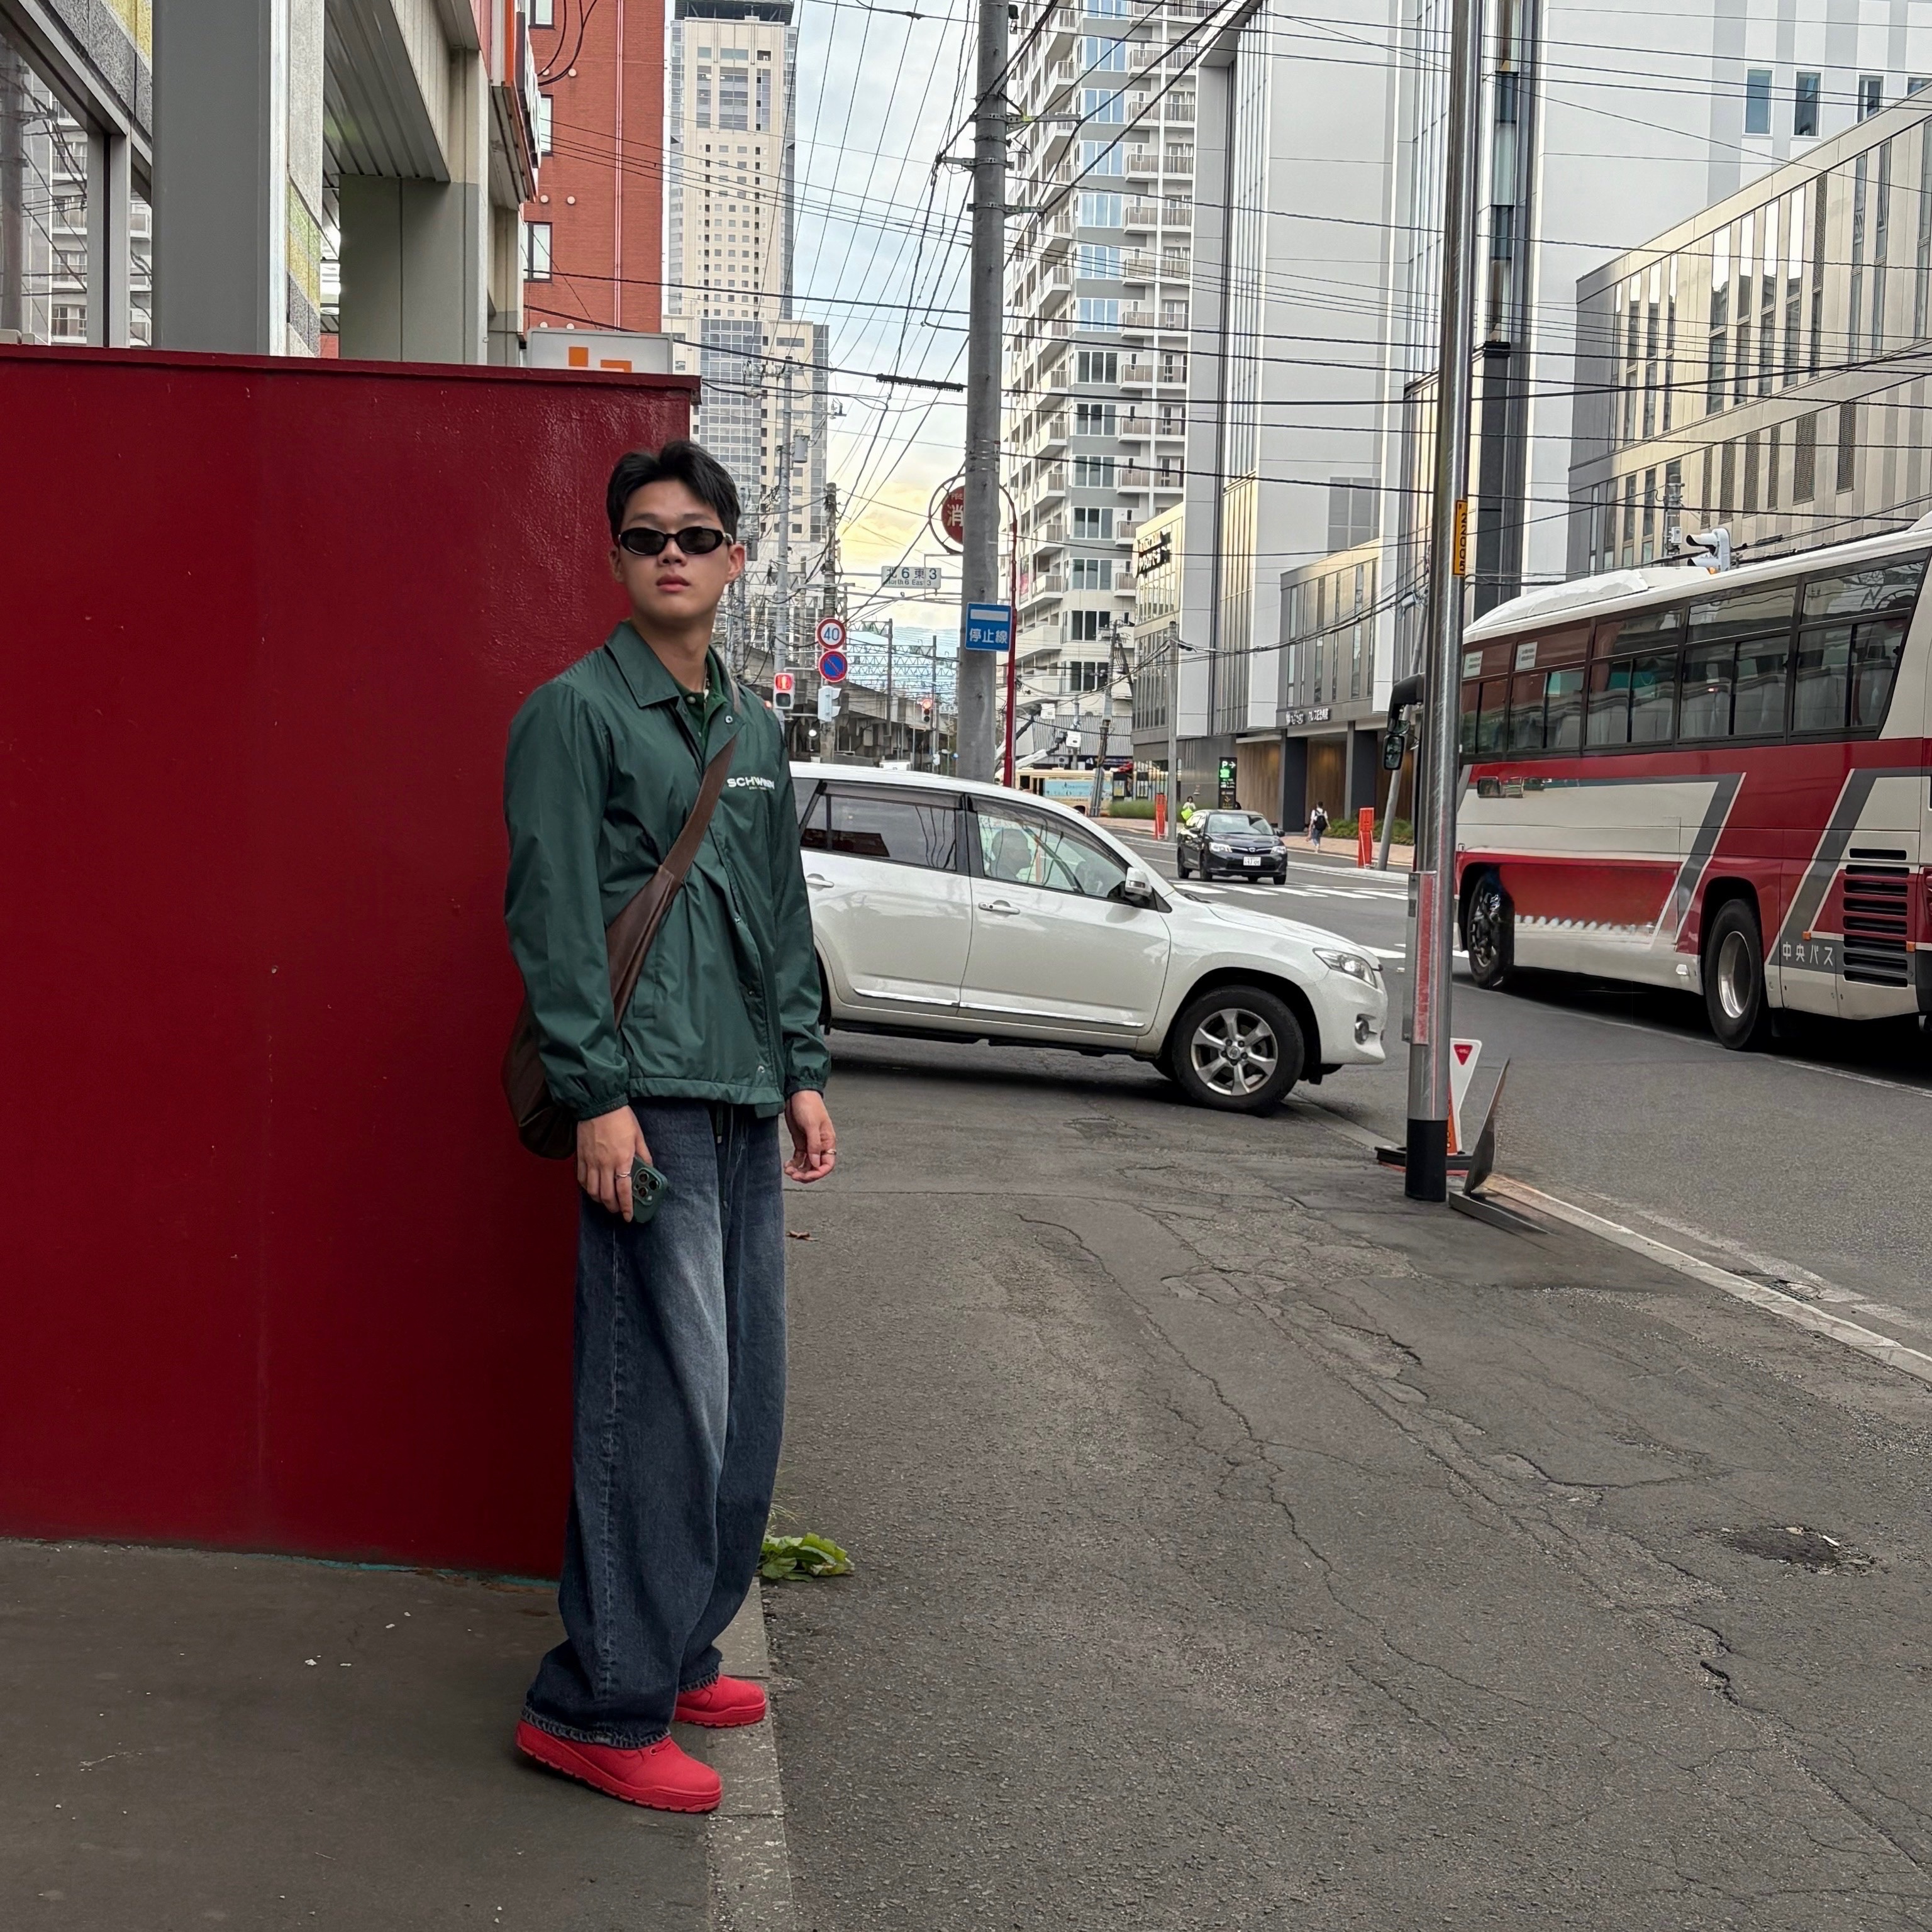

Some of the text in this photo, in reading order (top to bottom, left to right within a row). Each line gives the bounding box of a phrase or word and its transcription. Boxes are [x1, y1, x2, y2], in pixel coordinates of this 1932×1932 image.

[823, 627, 840, 641] 40
[969, 628, 1008, 644] 停止線
[1222, 760, 1228, 769] P
[1782, 941, 1833, 967] 中央バス
